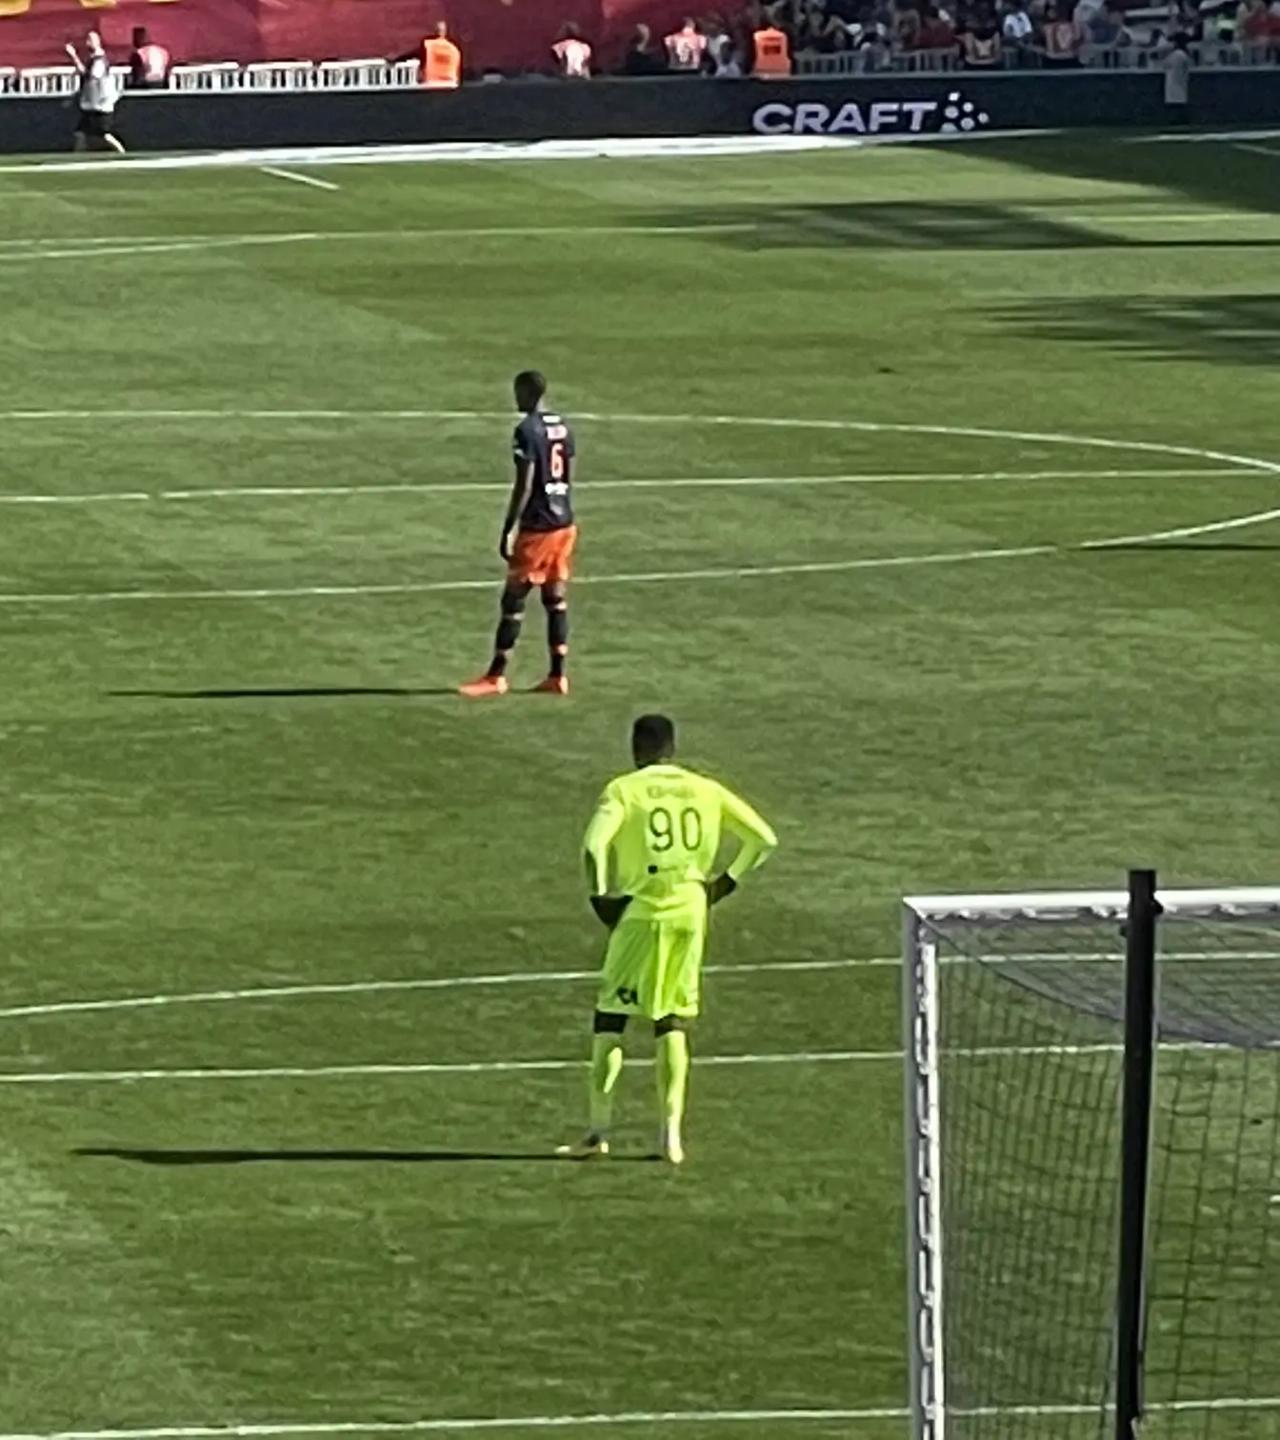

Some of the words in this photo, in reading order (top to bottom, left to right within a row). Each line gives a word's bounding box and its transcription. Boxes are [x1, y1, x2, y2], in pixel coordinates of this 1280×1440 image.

[752, 101, 937, 134] CRAFT
[551, 441, 565, 480] 6
[648, 805, 703, 853] 90
